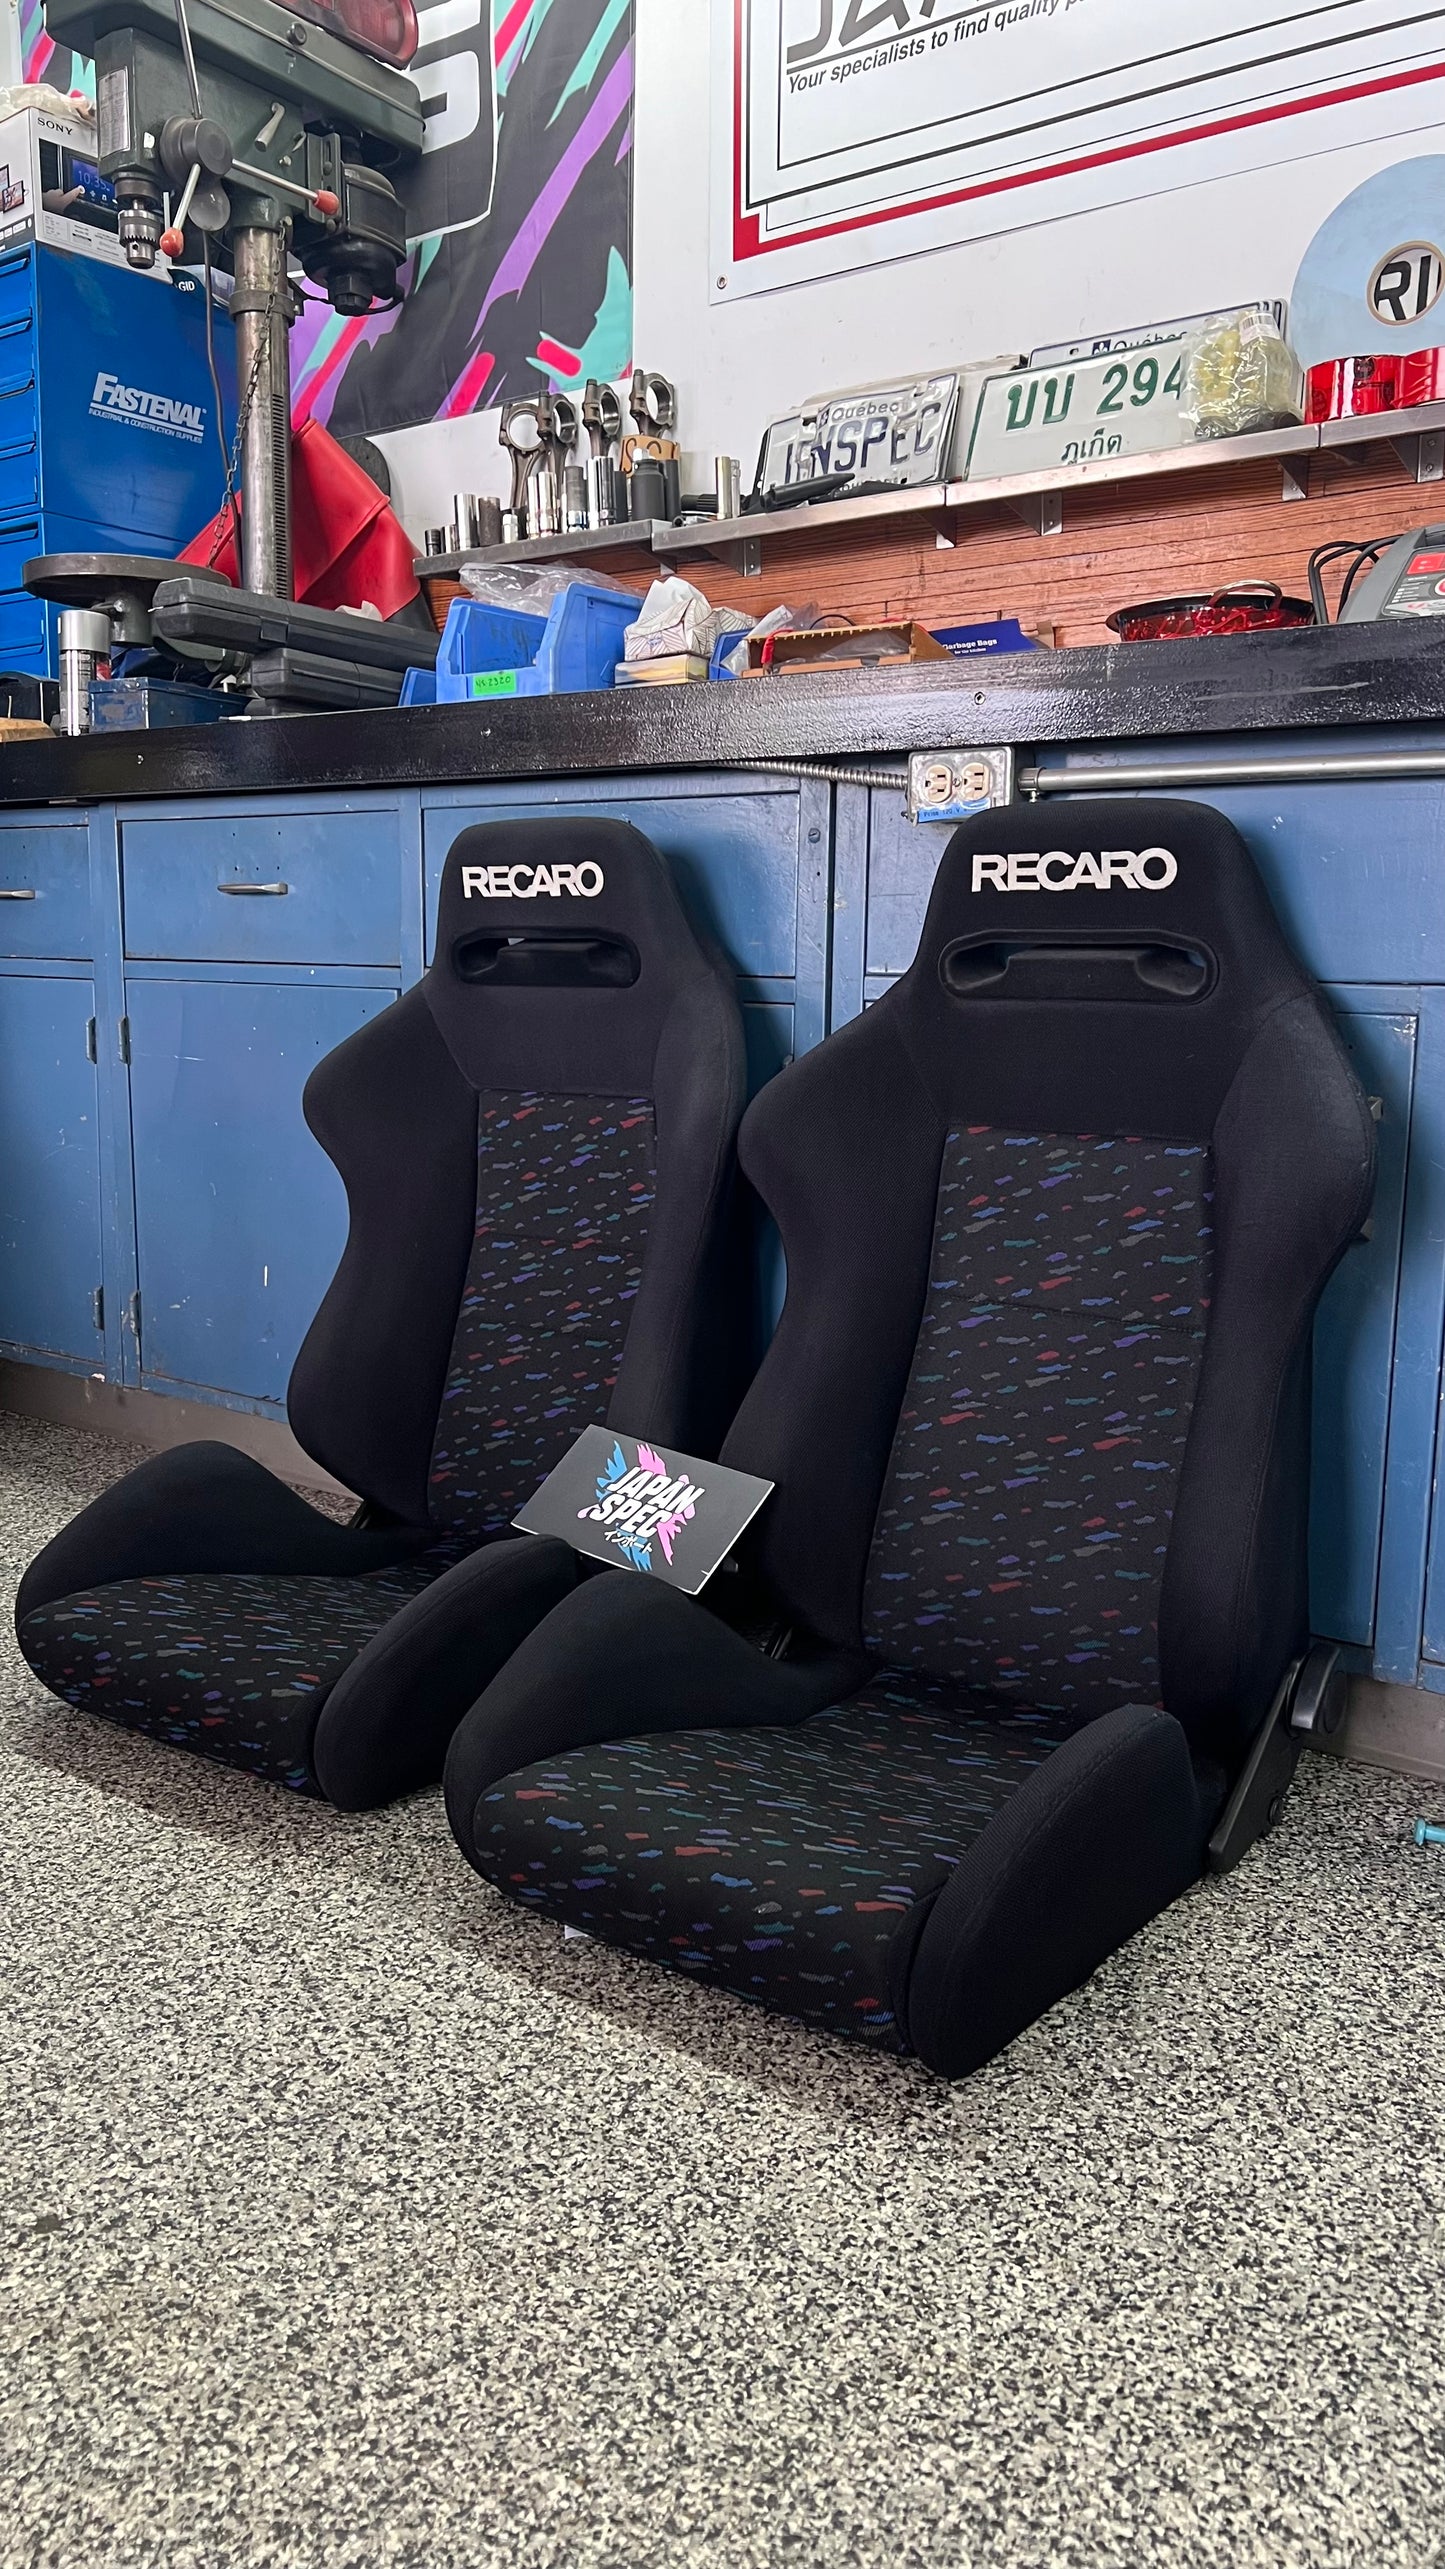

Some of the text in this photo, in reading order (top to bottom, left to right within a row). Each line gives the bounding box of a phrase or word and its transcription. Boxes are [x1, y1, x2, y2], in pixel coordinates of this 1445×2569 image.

[789, 0, 1059, 94] Your specialists to find quality
[37, 117, 73, 136] SONY
[92, 371, 206, 431] FASTENAL
[831, 401, 900, 424] Québec
[88, 407, 123, 424] INDUSTRIAL
[130, 418, 175, 437] CONSTRUCTION
[175, 431, 203, 444] SUPPLIES
[942, 642, 976, 650] Garbage
[461, 861, 604, 898] RECARO
[971, 849, 1177, 892] RECARO
[607, 1467, 705, 1515] JAPAN
[589, 1493, 673, 1538] SPEC
[604, 1530, 653, 1554] インポート
